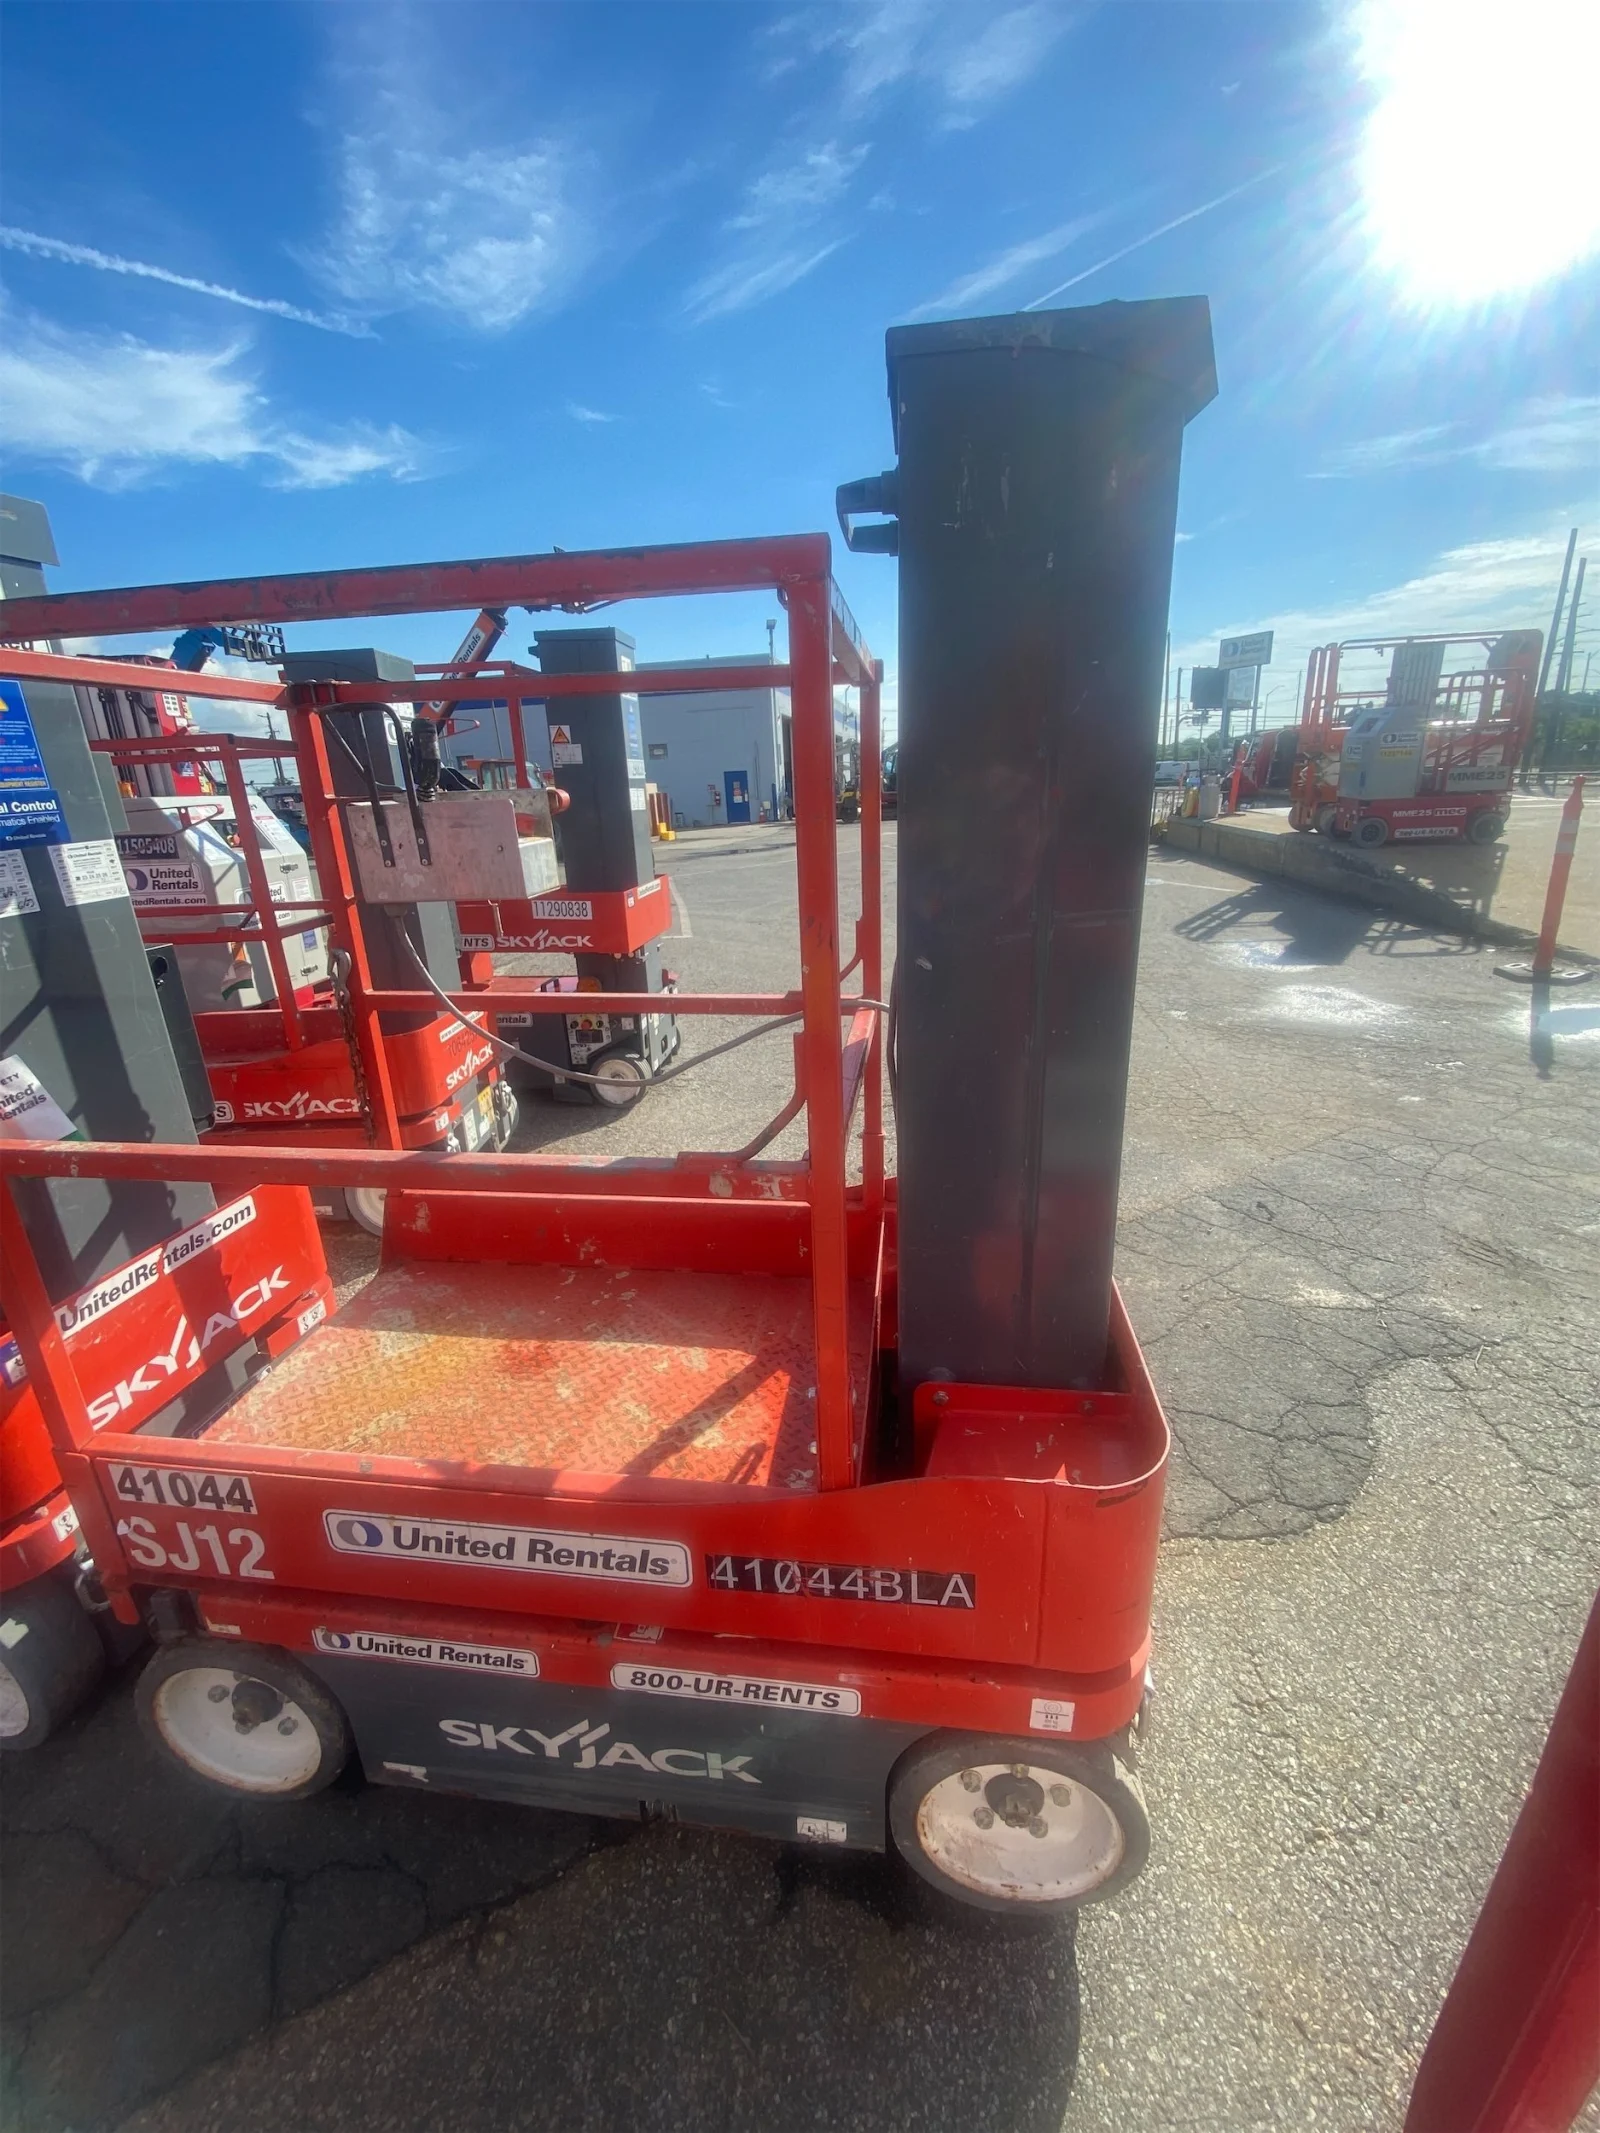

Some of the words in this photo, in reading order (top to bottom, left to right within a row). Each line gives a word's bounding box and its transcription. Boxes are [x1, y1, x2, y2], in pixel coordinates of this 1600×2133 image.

[1448, 771, 1506, 782] MME25
[11, 799, 57, 812] Control
[27, 814, 60, 824] Enabled
[1392, 808, 1432, 818] MME25
[150, 868, 193, 880] United
[152, 880, 199, 891] Rentals
[533, 901, 589, 918] 11290838
[497, 929, 594, 949] SKYJACK
[446, 1042, 494, 1090] SKYJACK
[60, 1204, 251, 1332] UnitedRentals.com
[87, 1263, 291, 1431] SKYJACK
[117, 1466, 254, 1513] 41044
[127, 1515, 275, 1580] SJ12
[392, 1525, 515, 1561] United
[527, 1537, 670, 1575] Rentals
[711, 1555, 975, 1608] 41044BLA
[356, 1636, 432, 1660] United
[439, 1646, 525, 1670] Rentals
[629, 1670, 841, 1709] 800-UR-RENTS
[438, 1718, 763, 1784] SKYJACK
